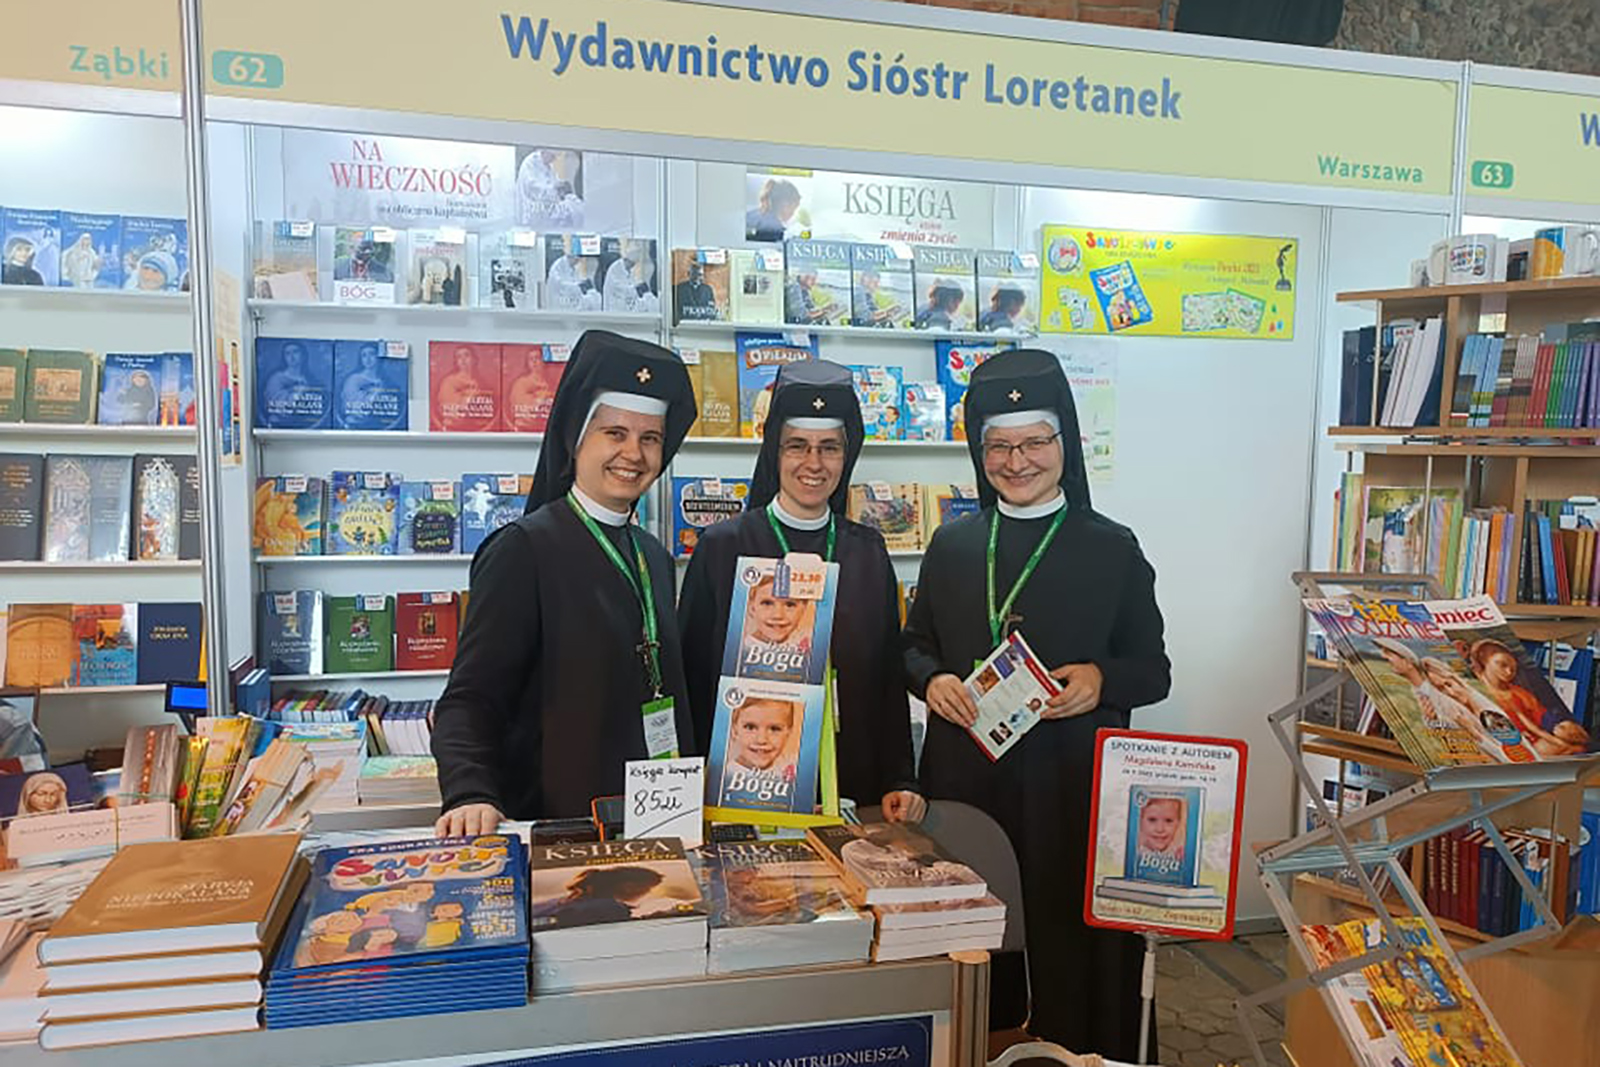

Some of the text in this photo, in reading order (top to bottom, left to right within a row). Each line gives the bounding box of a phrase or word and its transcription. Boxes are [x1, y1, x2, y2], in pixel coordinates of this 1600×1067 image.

[68, 45, 169, 79] Ząbki
[228, 57, 268, 84] 62
[501, 14, 1181, 119] Wydawnictwo Sióstr Loretanek
[352, 140, 383, 162] NA
[330, 162, 493, 197] WIECZNOŚĆ
[1317, 154, 1424, 183] Warszawa
[1480, 164, 1504, 185] 63
[842, 182, 958, 225] KSIĘGA
[856, 246, 887, 266] KSIĘ
[339, 284, 376, 299] BÓG
[744, 645, 804, 673] Boga
[1111, 741, 1168, 756] SPOTKANIE
[1182, 748, 1233, 760] AUTOREM
[726, 770, 790, 801] Boga
[544, 839, 671, 861] KSIĘGA
[1138, 853, 1181, 874] Boga
